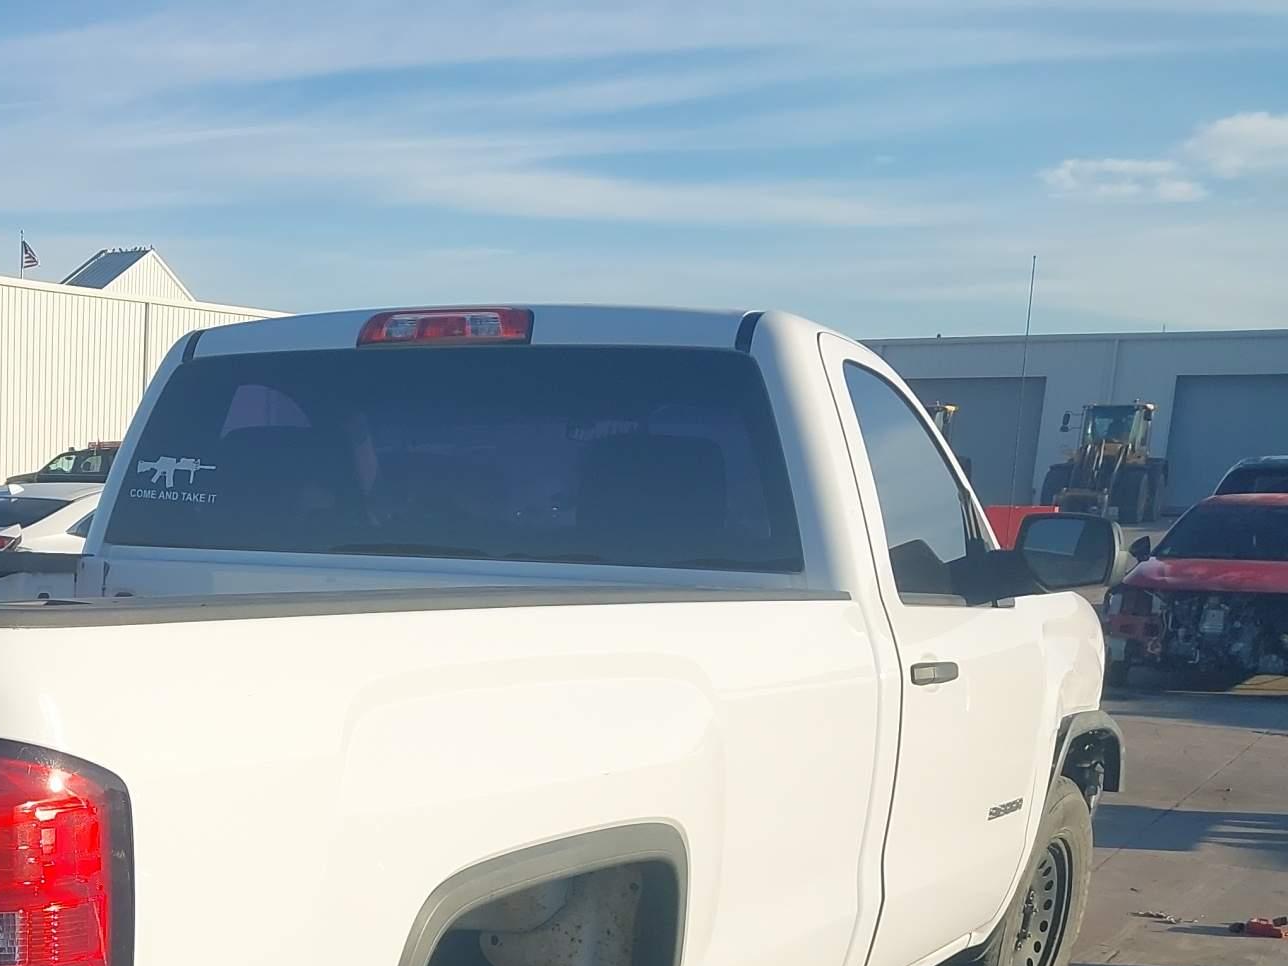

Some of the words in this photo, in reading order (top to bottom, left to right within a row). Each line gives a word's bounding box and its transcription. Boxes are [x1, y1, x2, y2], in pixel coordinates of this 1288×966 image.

[129, 488, 157, 499] COME
[158, 490, 179, 501] AND
[181, 492, 206, 503] TAKE
[208, 494, 217, 504] IT
